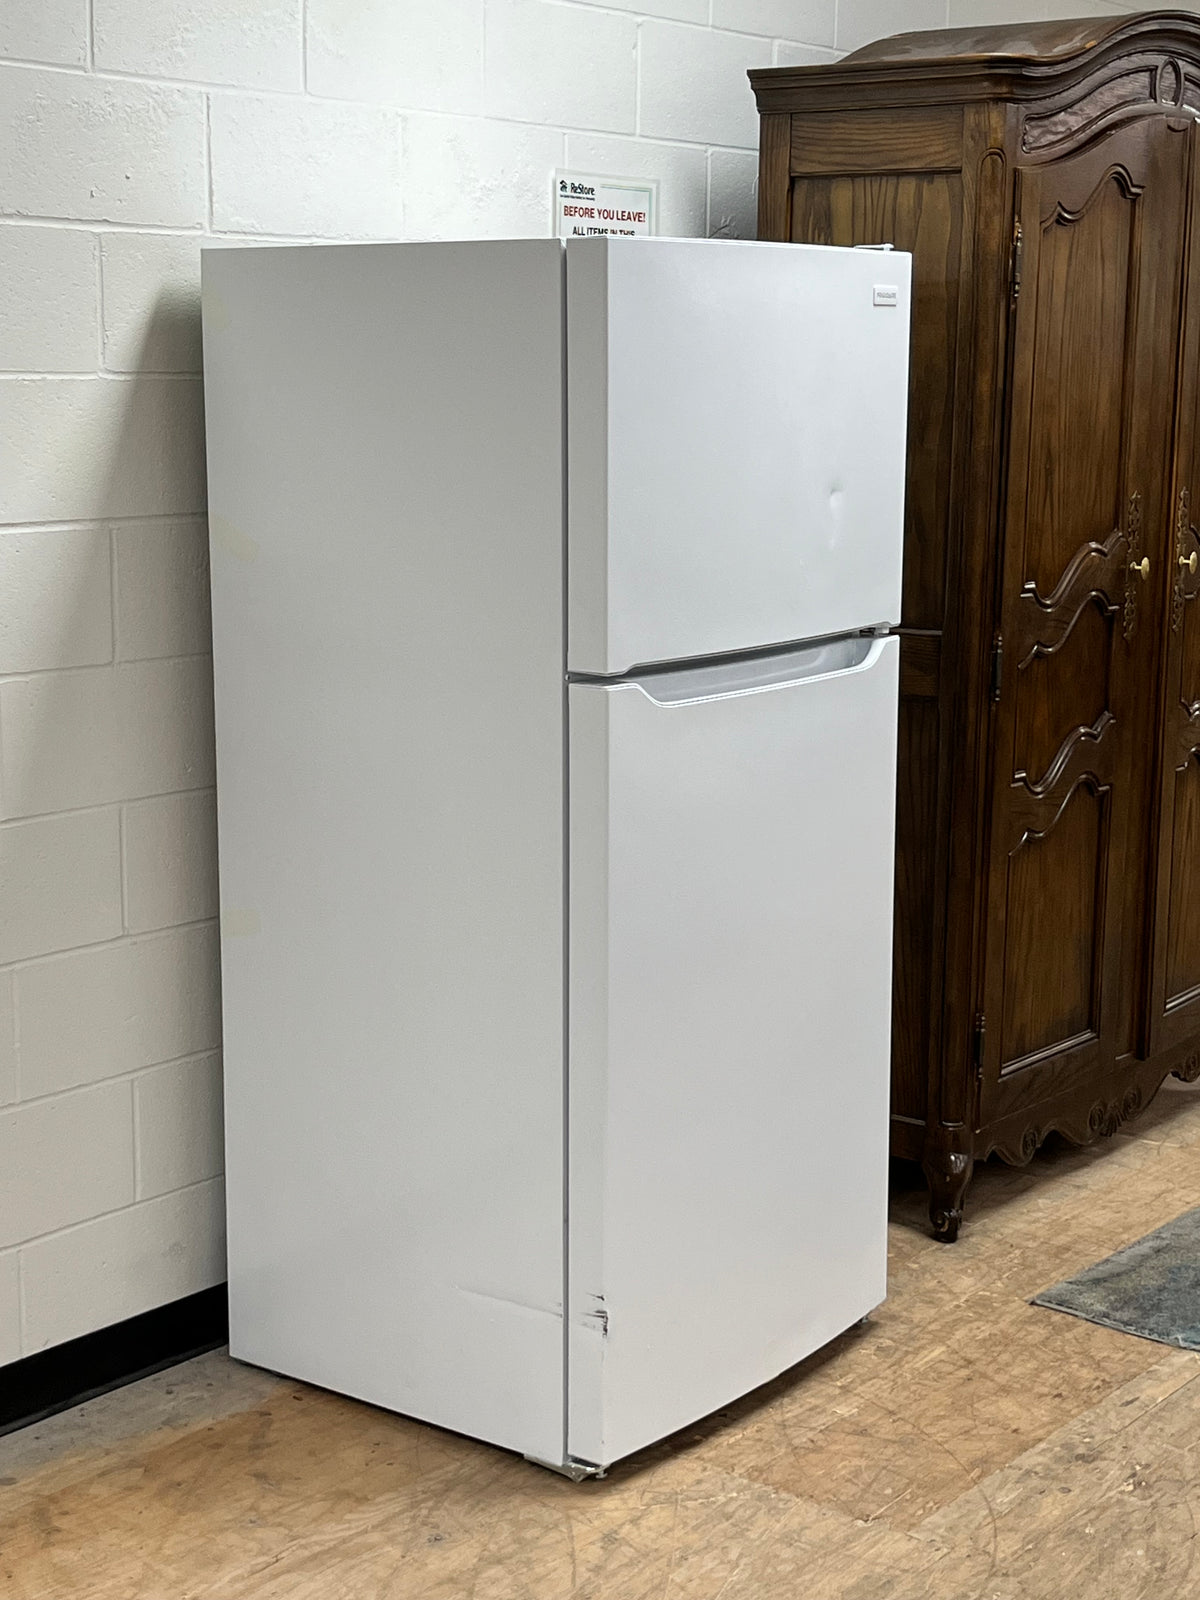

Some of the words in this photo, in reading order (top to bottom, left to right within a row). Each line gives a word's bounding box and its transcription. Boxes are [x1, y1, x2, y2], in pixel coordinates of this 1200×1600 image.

[570, 182, 595, 195] ReStore
[563, 205, 595, 218] BEFORE
[597, 209, 615, 220] YOU
[616, 210, 646, 222] LEAVE!
[572, 226, 586, 236] ALL
